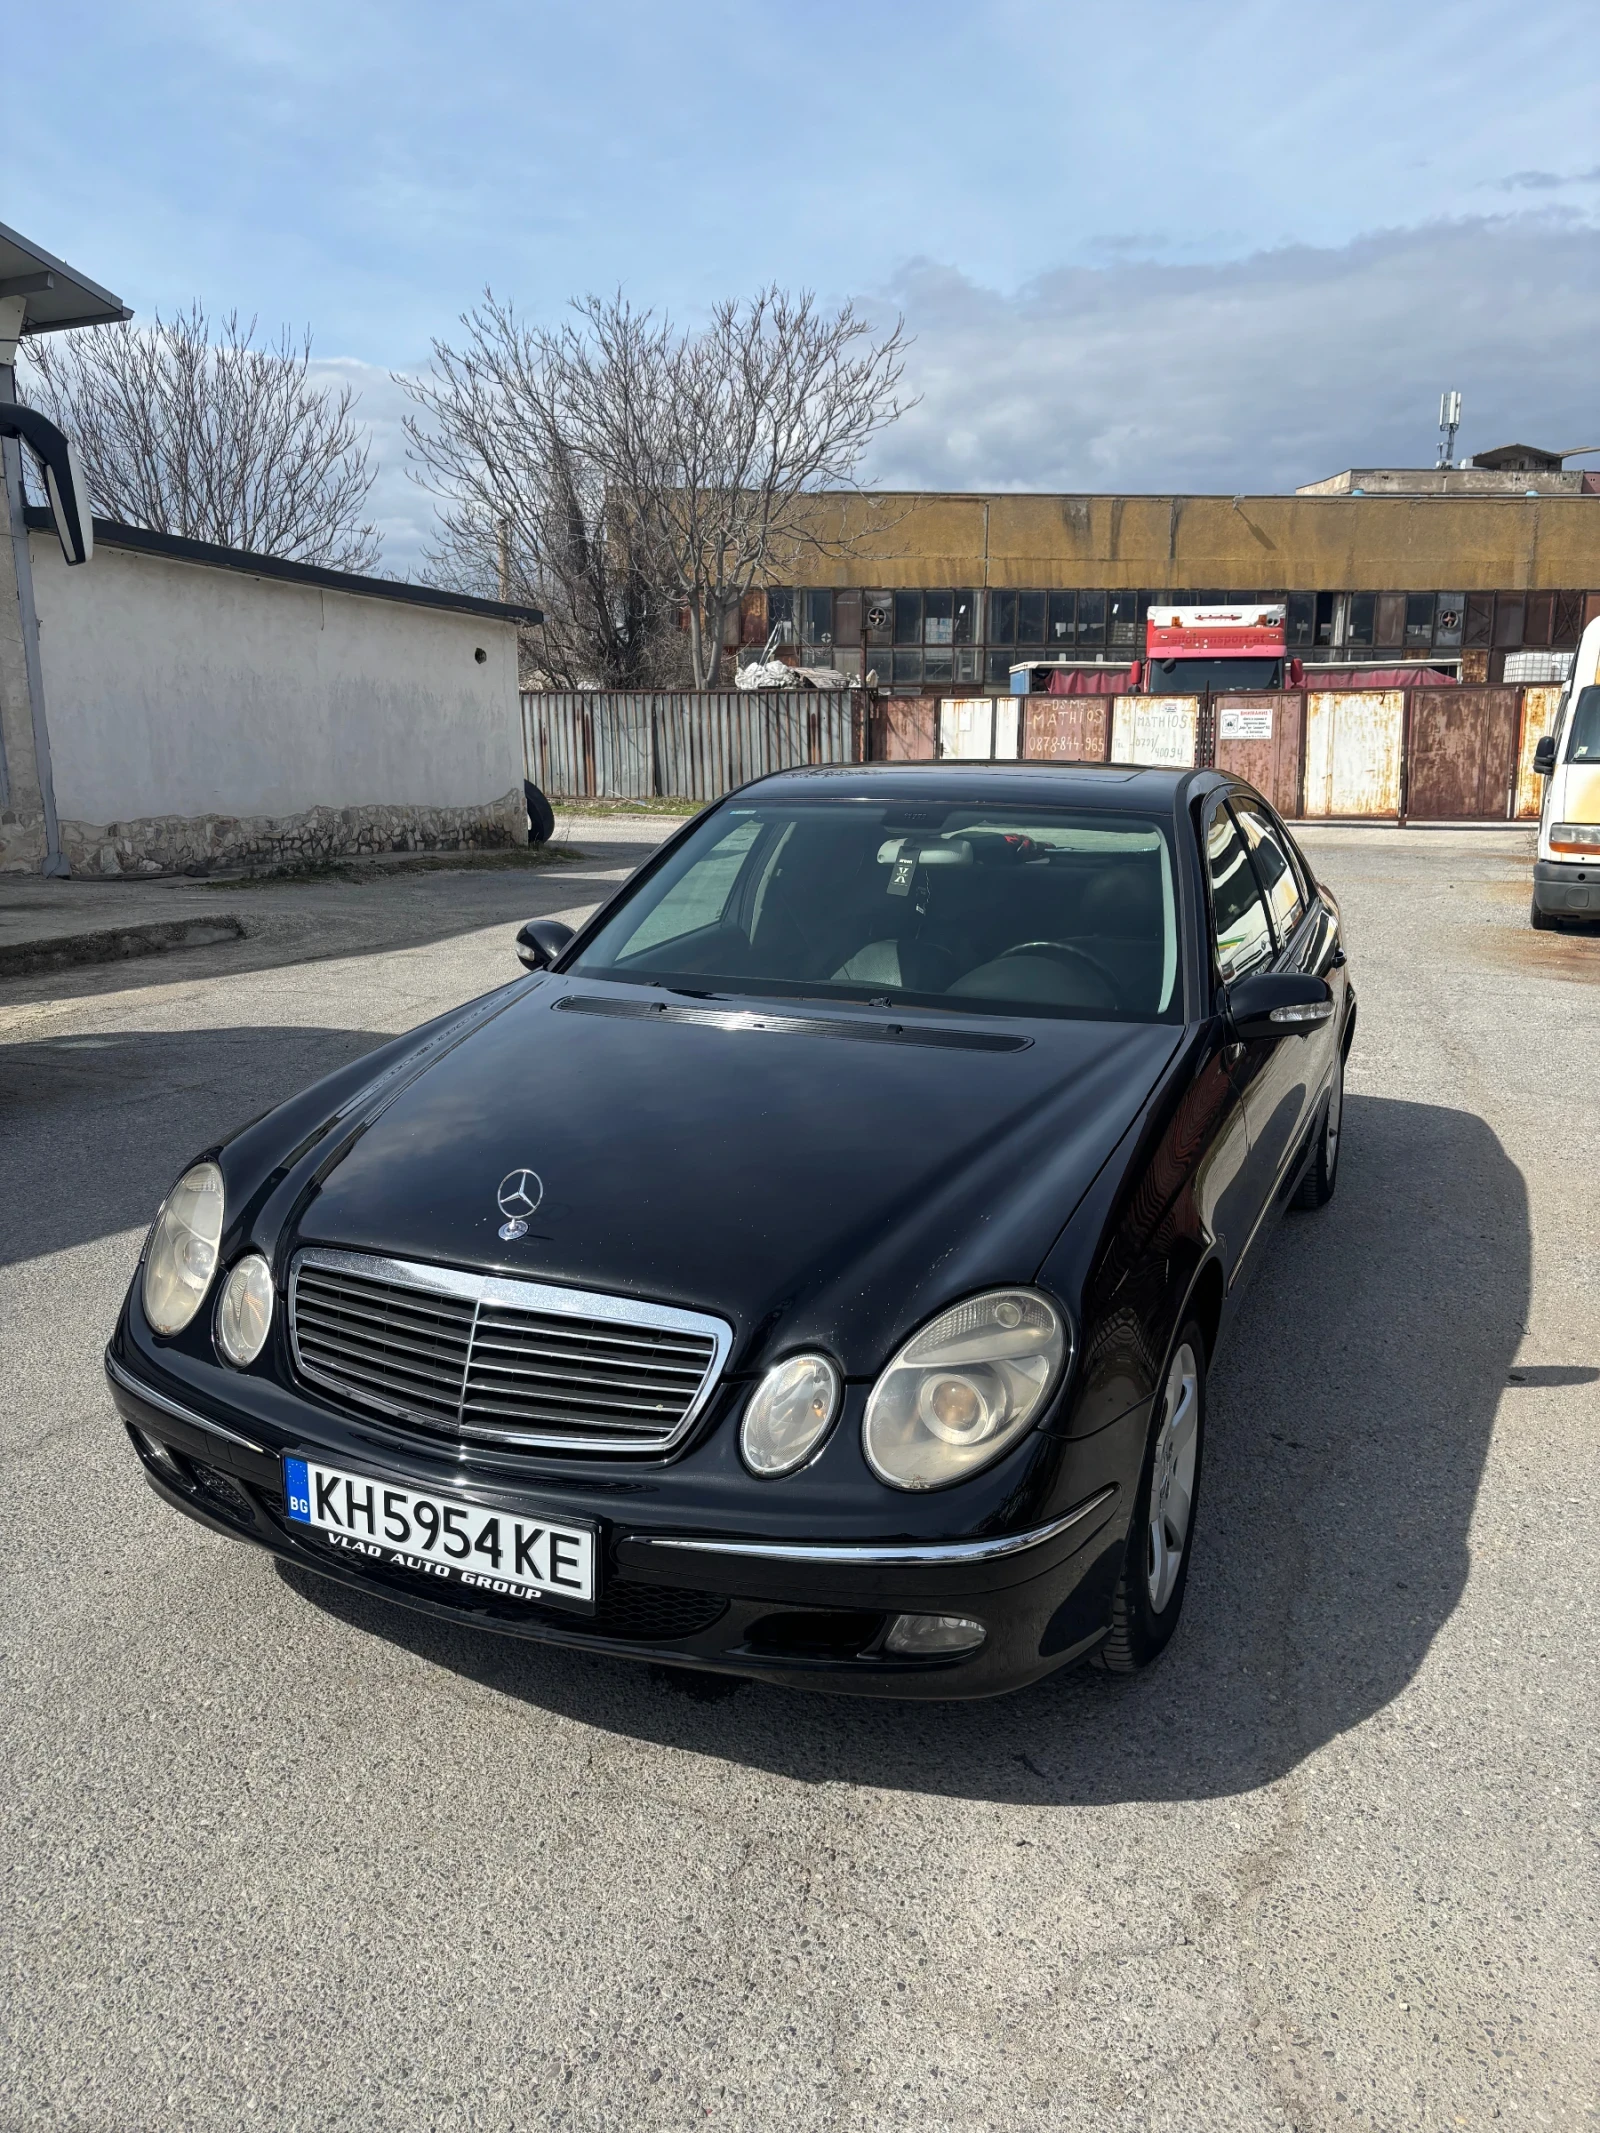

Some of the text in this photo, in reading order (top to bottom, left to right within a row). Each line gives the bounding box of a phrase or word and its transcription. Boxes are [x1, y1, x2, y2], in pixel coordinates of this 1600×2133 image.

[1137, 714, 1189, 729] MATHIOS
[290, 1496, 308, 1514] BG
[328, 1532, 542, 1600] VLAD AUTO GROUP
